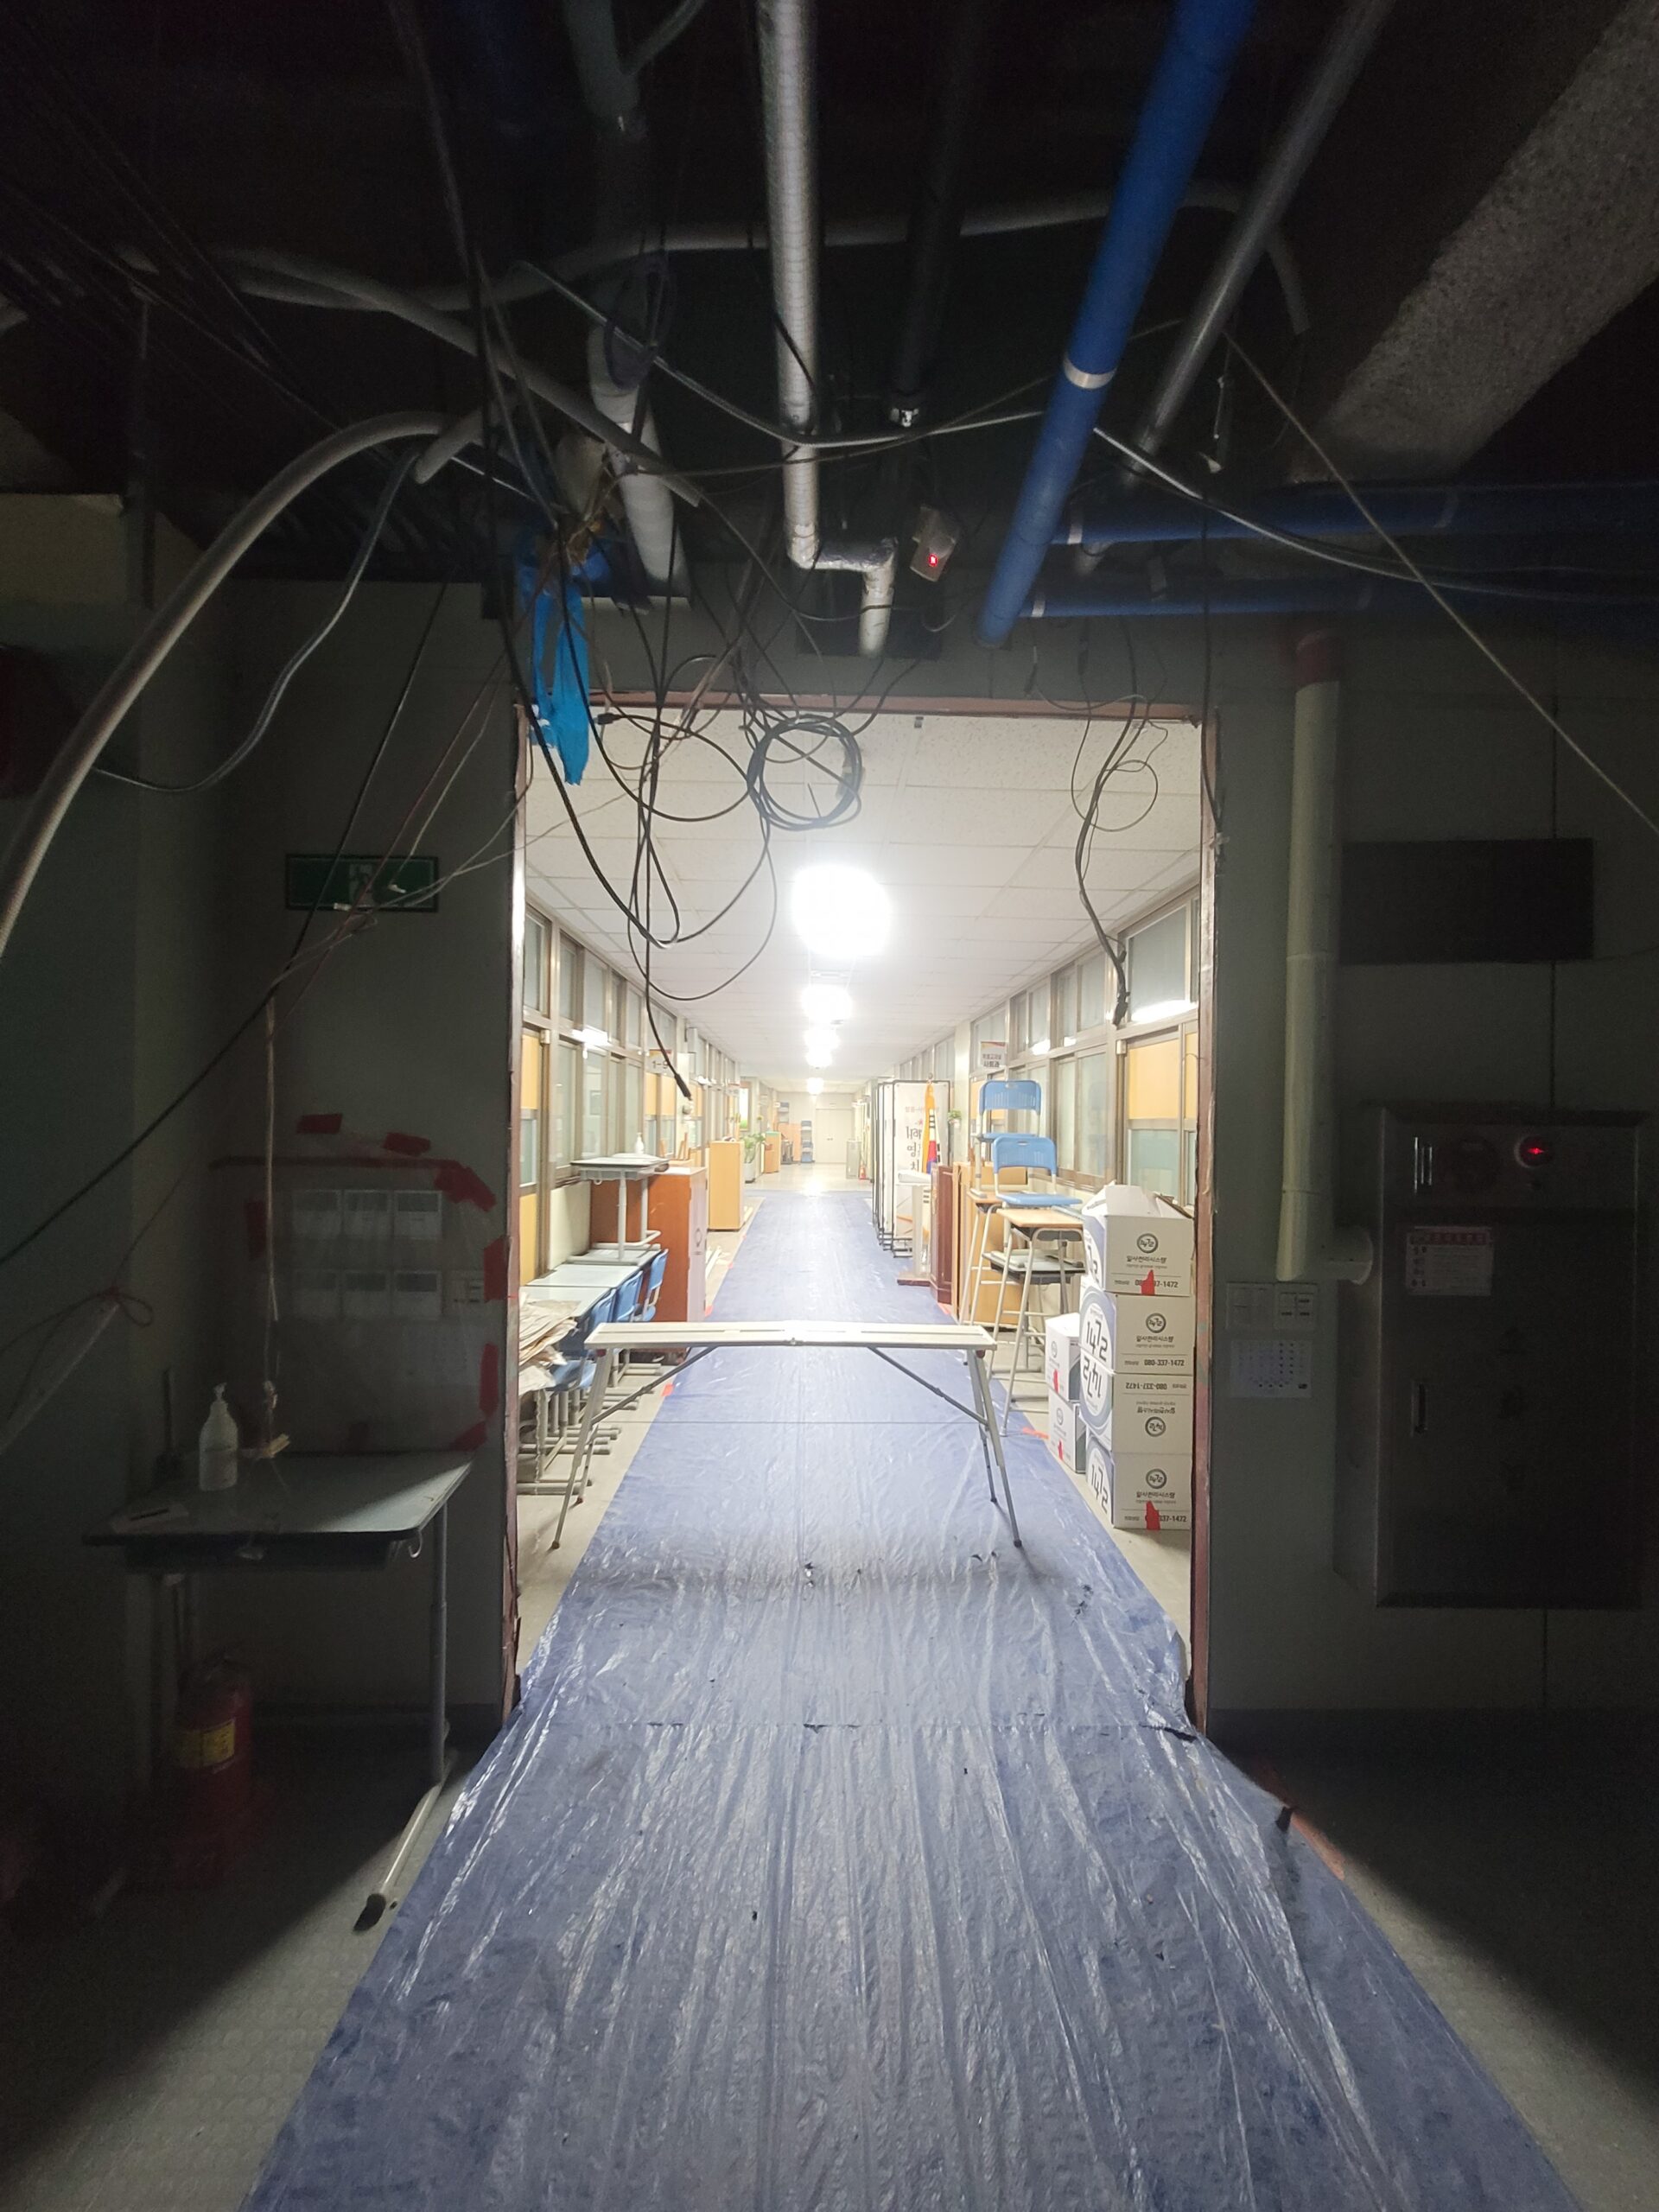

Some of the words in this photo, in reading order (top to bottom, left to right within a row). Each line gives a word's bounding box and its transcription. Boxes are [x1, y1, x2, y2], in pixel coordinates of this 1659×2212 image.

[1086, 1319, 1108, 1362] 1472
[1144, 1358, 1185, 1367] 080-337-1472
[1125, 1382, 1167, 1390] 080-337-1472
[1090, 1463, 1108, 1514] 1472
